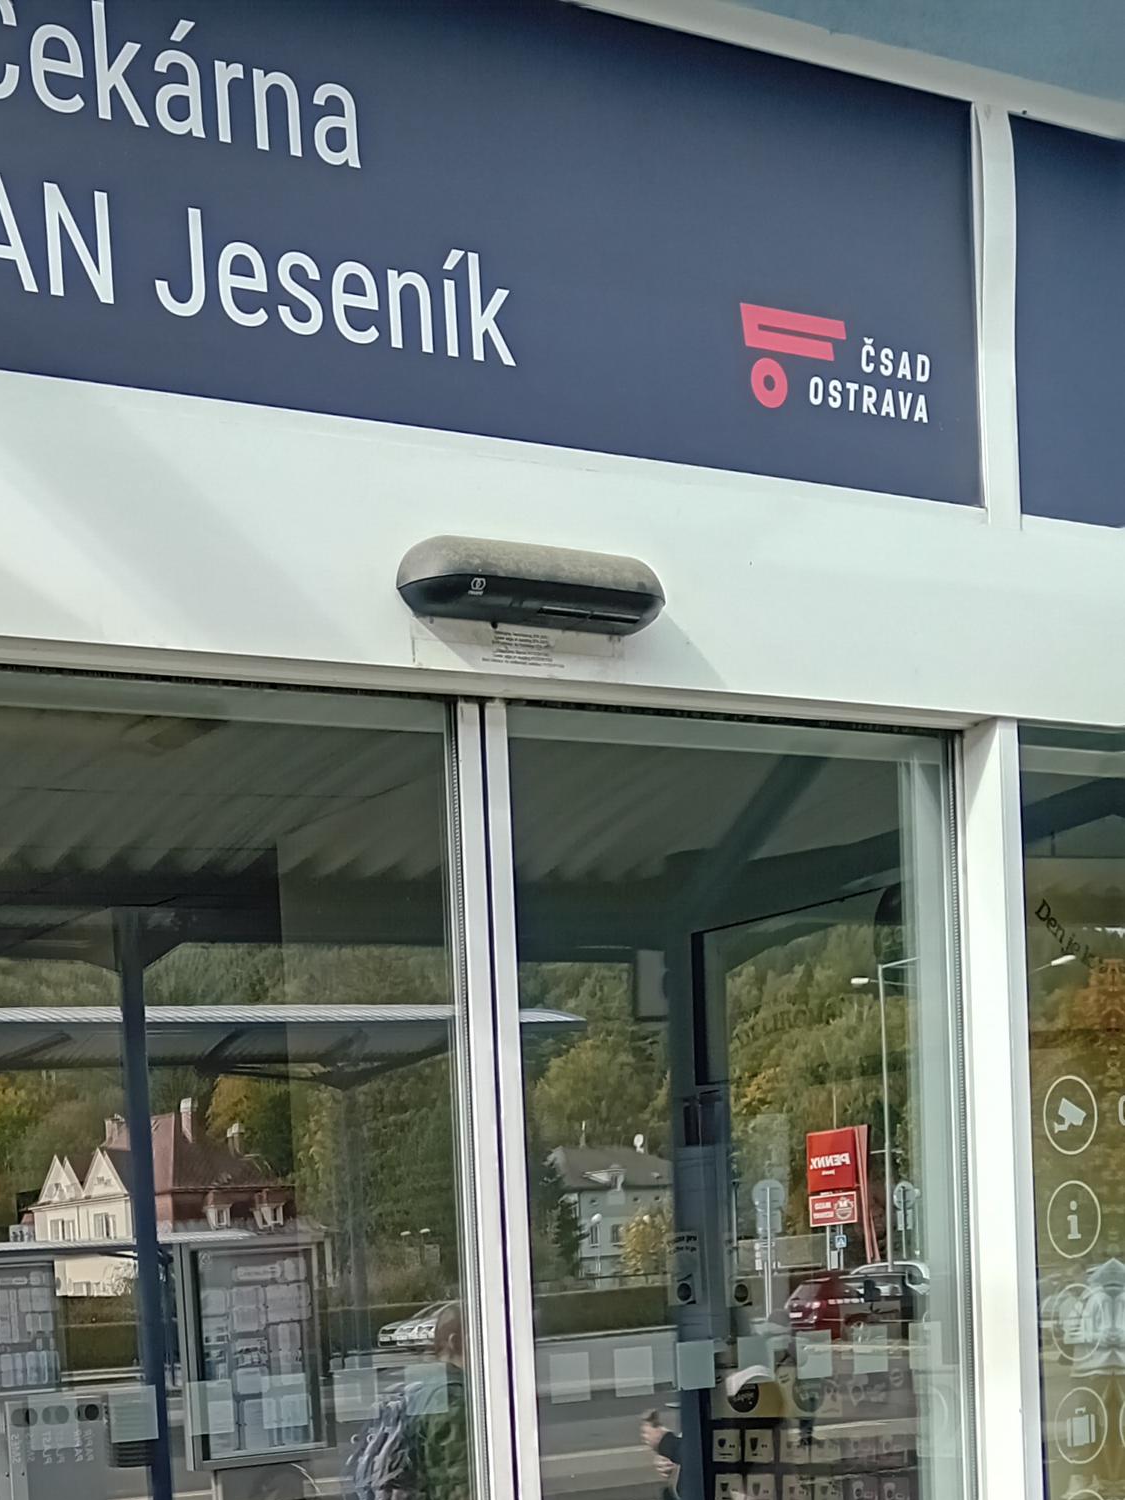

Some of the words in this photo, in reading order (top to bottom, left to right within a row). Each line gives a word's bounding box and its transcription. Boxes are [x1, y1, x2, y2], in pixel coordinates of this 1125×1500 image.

[155, 207, 516, 367] Jeseník
[861, 337, 931, 383] ČSAD
[809, 376, 929, 424] OSTRAVA
